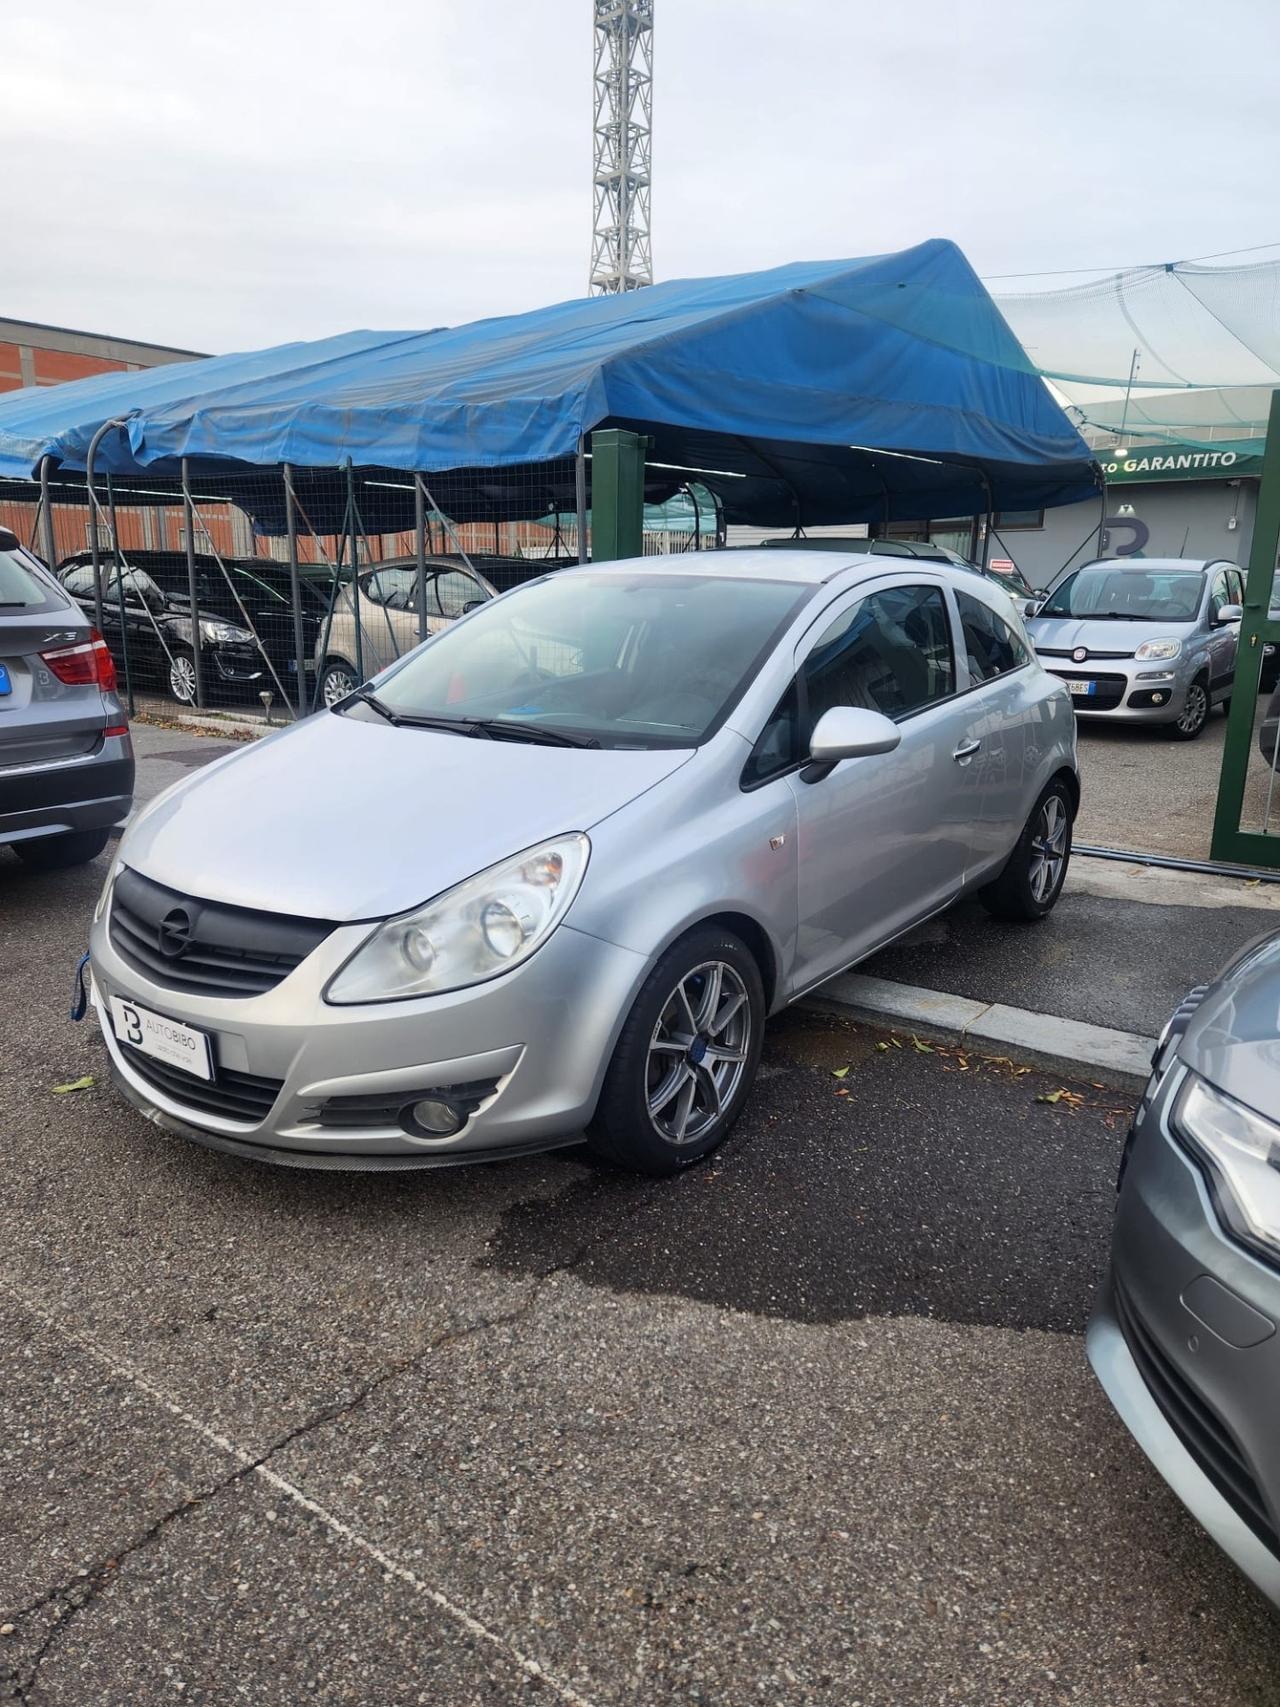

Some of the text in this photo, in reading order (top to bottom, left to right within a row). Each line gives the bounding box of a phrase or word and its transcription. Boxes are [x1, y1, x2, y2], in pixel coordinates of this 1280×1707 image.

[1123, 451, 1237, 473] GARANTITO
[42, 631, 78, 642] X3
[146, 1019, 196, 1051] AUTOBIBO
